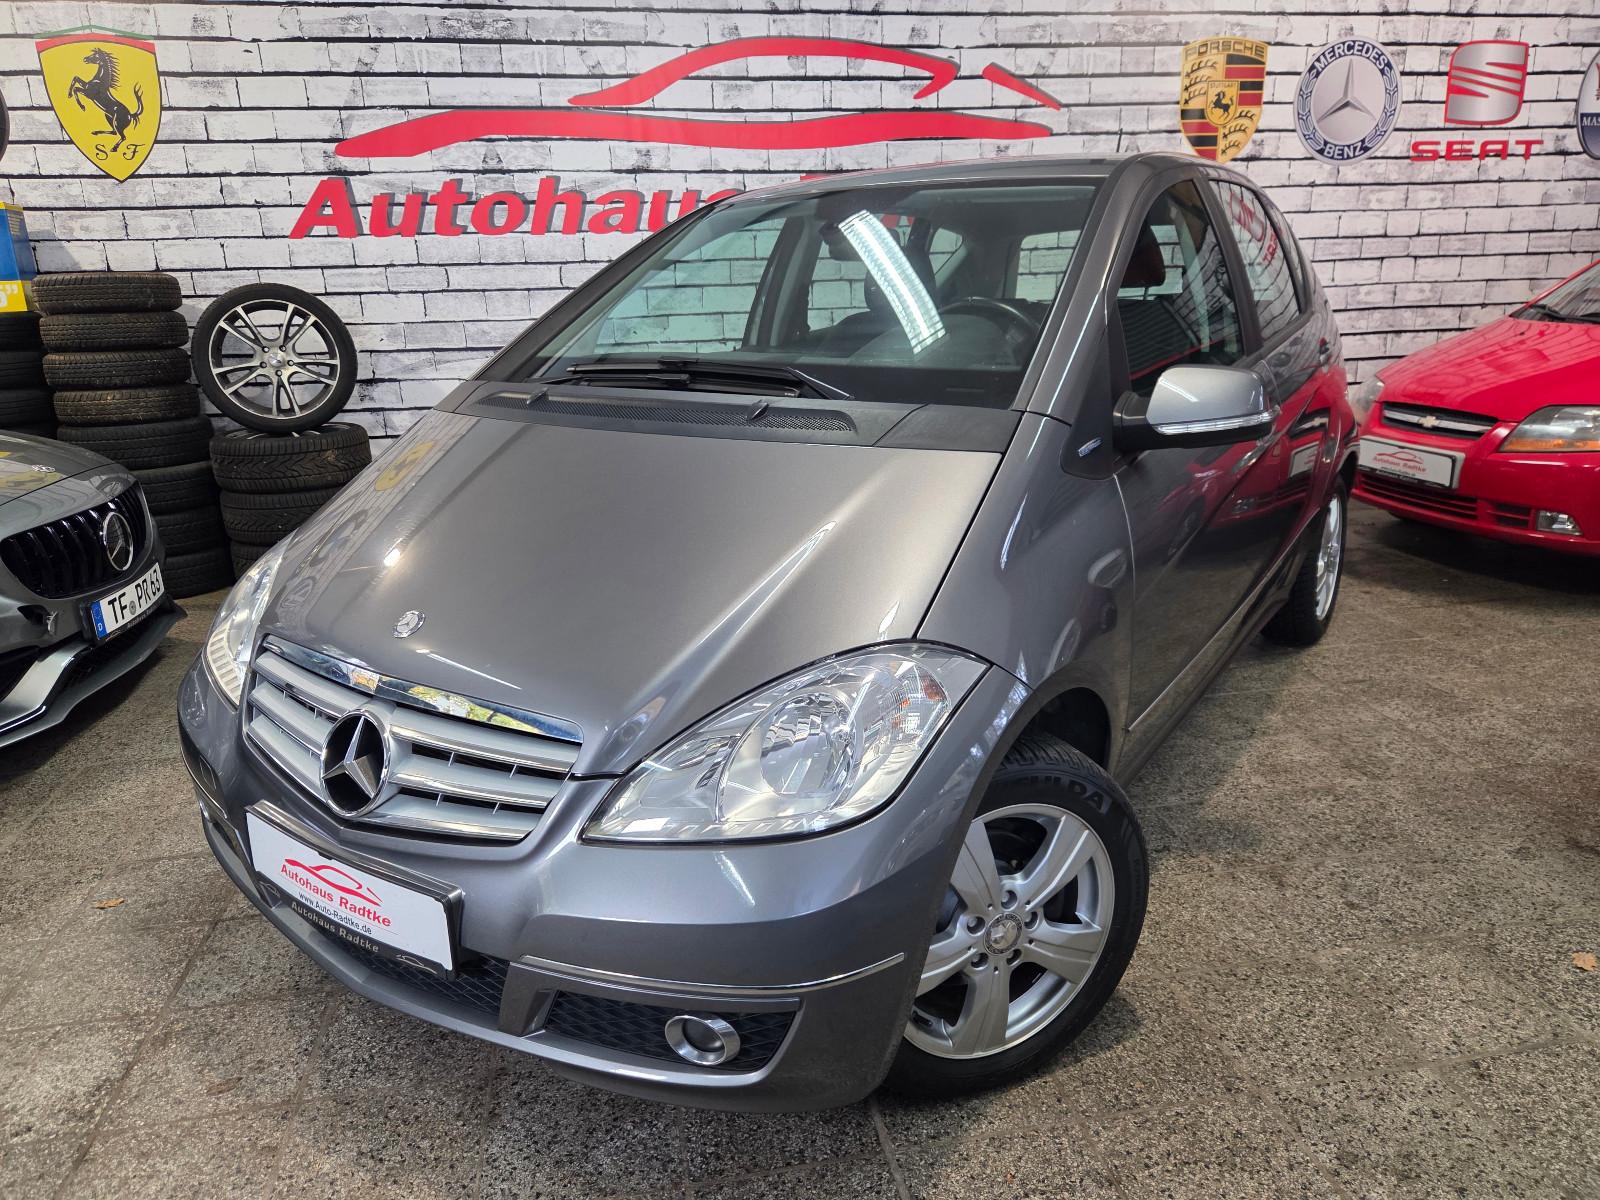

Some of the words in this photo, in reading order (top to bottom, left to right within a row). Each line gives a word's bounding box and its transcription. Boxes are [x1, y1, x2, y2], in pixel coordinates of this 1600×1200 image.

[1185, 40, 1265, 60] PORSCHE
[1315, 41, 1388, 71] MERCEDES
[95, 143, 109, 161] S
[122, 143, 146, 161] F
[1323, 142, 1365, 159] BENZ
[1410, 139, 1545, 162] SEAT
[108, 591, 128, 625] TF
[134, 579, 151, 609] PR
[149, 569, 161, 597] 63
[280, 863, 334, 902] Autohaus
[339, 895, 392, 927] Radtke
[291, 901, 336, 933] Autohaus
[339, 927, 380, 953] Radtke
[298, 891, 373, 935] www.Auto-Radtke.de
